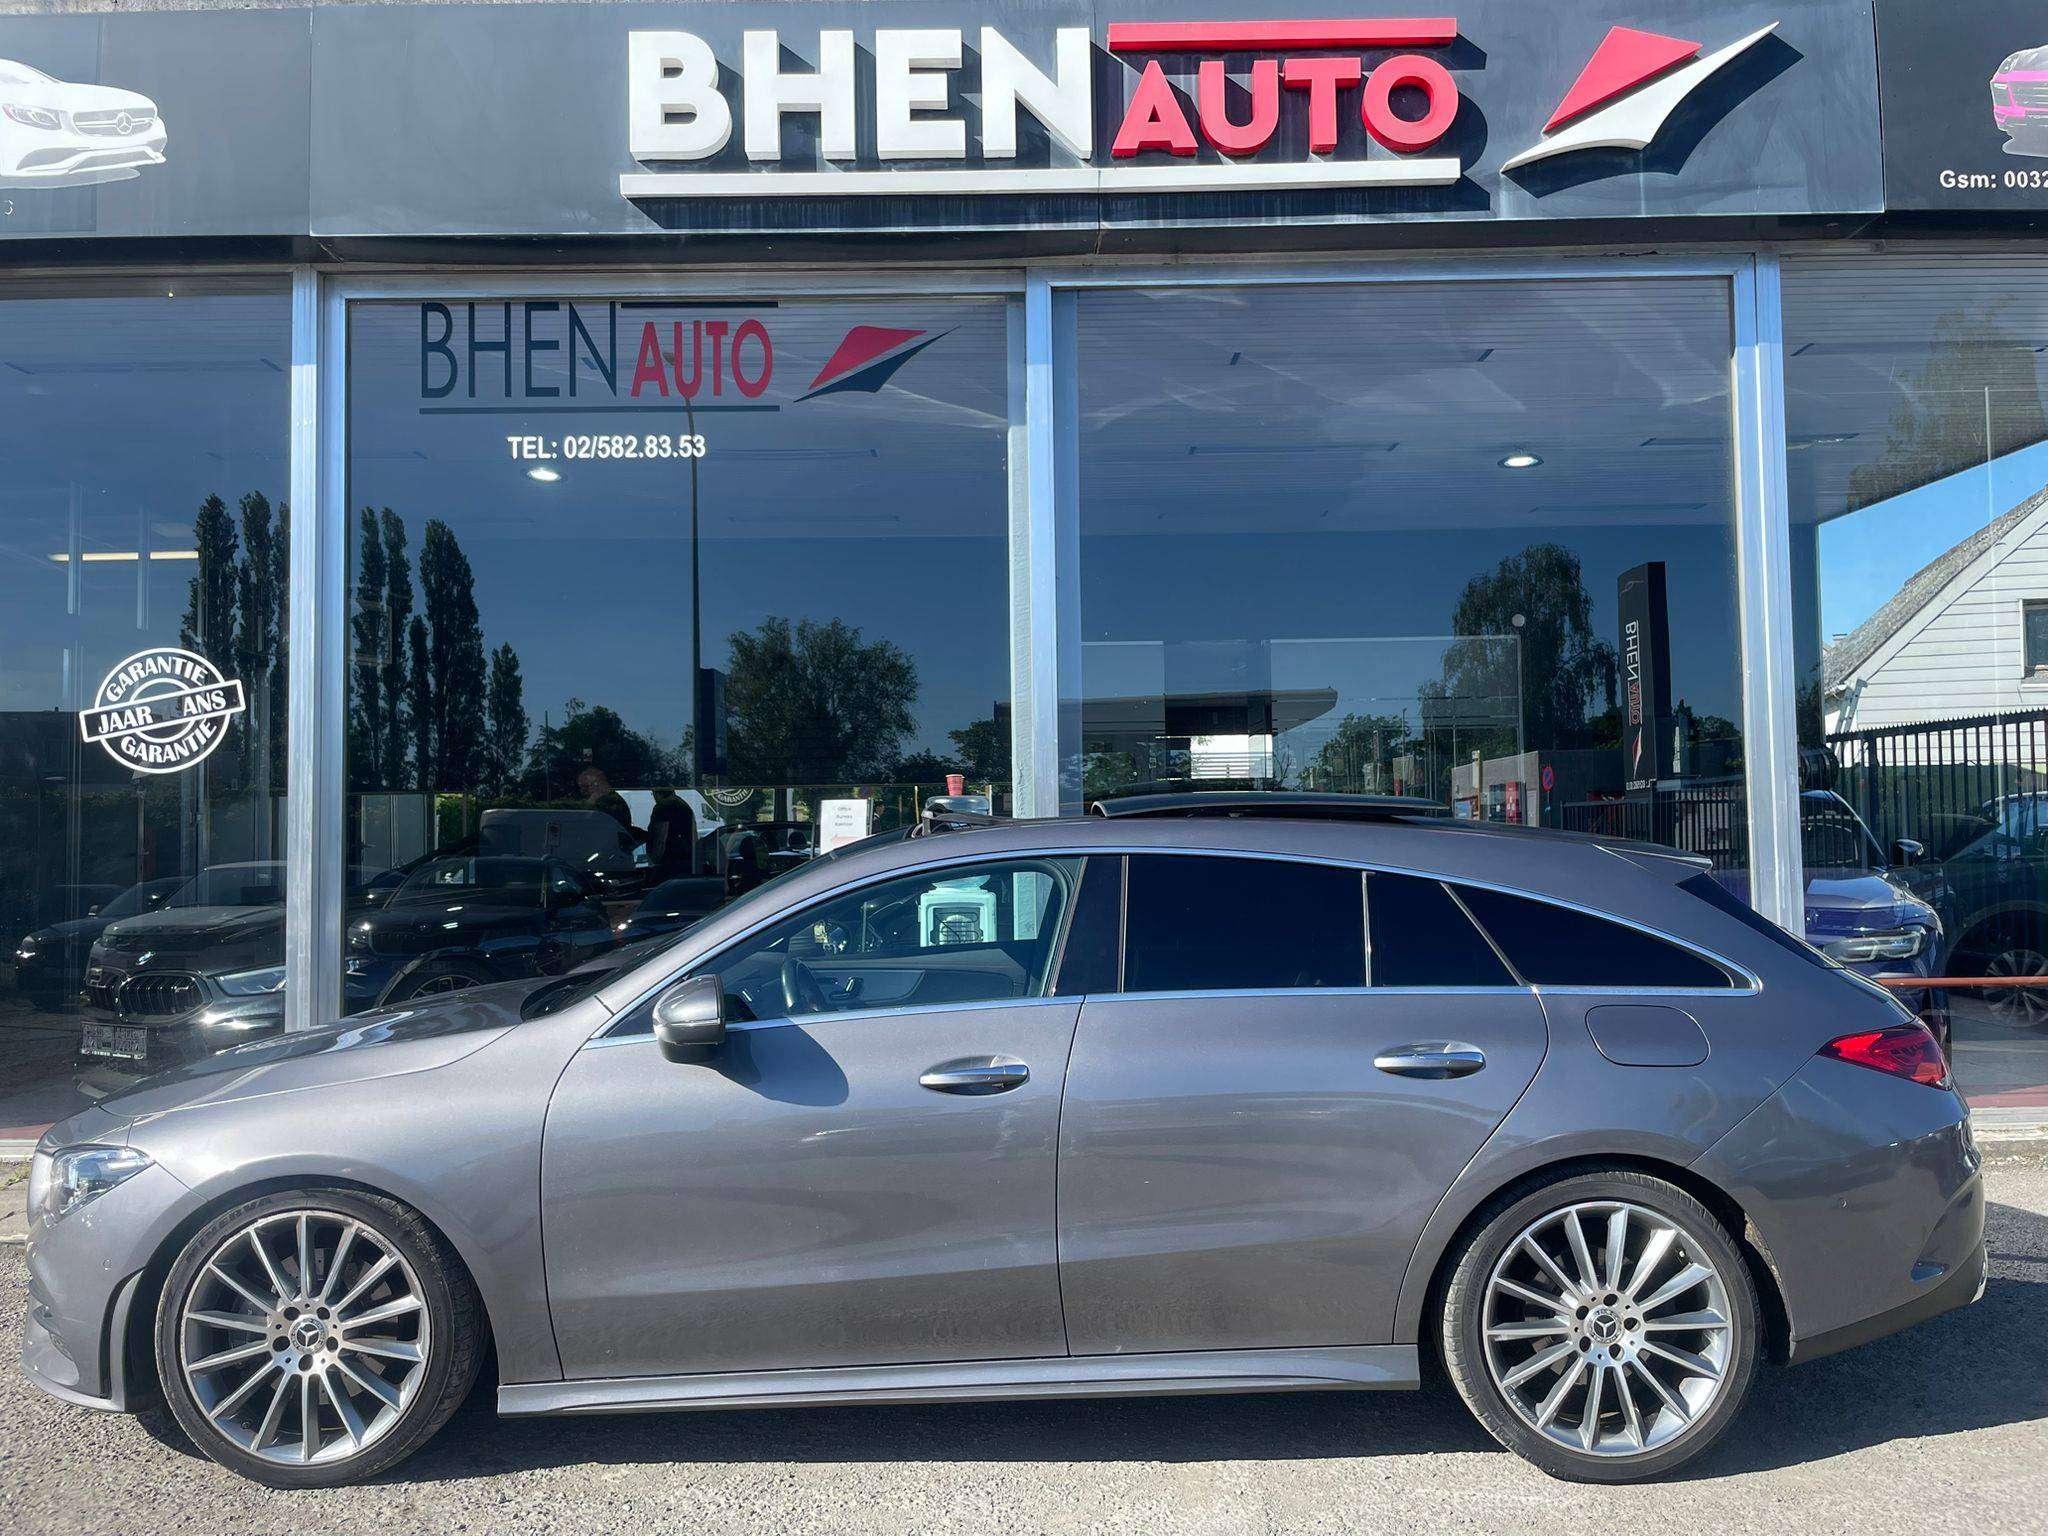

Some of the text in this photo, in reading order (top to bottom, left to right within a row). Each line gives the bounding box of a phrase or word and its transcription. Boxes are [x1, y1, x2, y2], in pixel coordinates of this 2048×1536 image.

[628, 26, 1459, 161] BHEN AUTO
[1940, 170, 1997, 189] Gsm:
[421, 301, 773, 398] BHEN AUTO
[507, 434, 706, 459] TEL: 02/582.83.53
[106, 656, 208, 702] GARANTIE
[98, 690, 227, 734] JAAR ANS
[120, 718, 218, 763] GARANTIE
